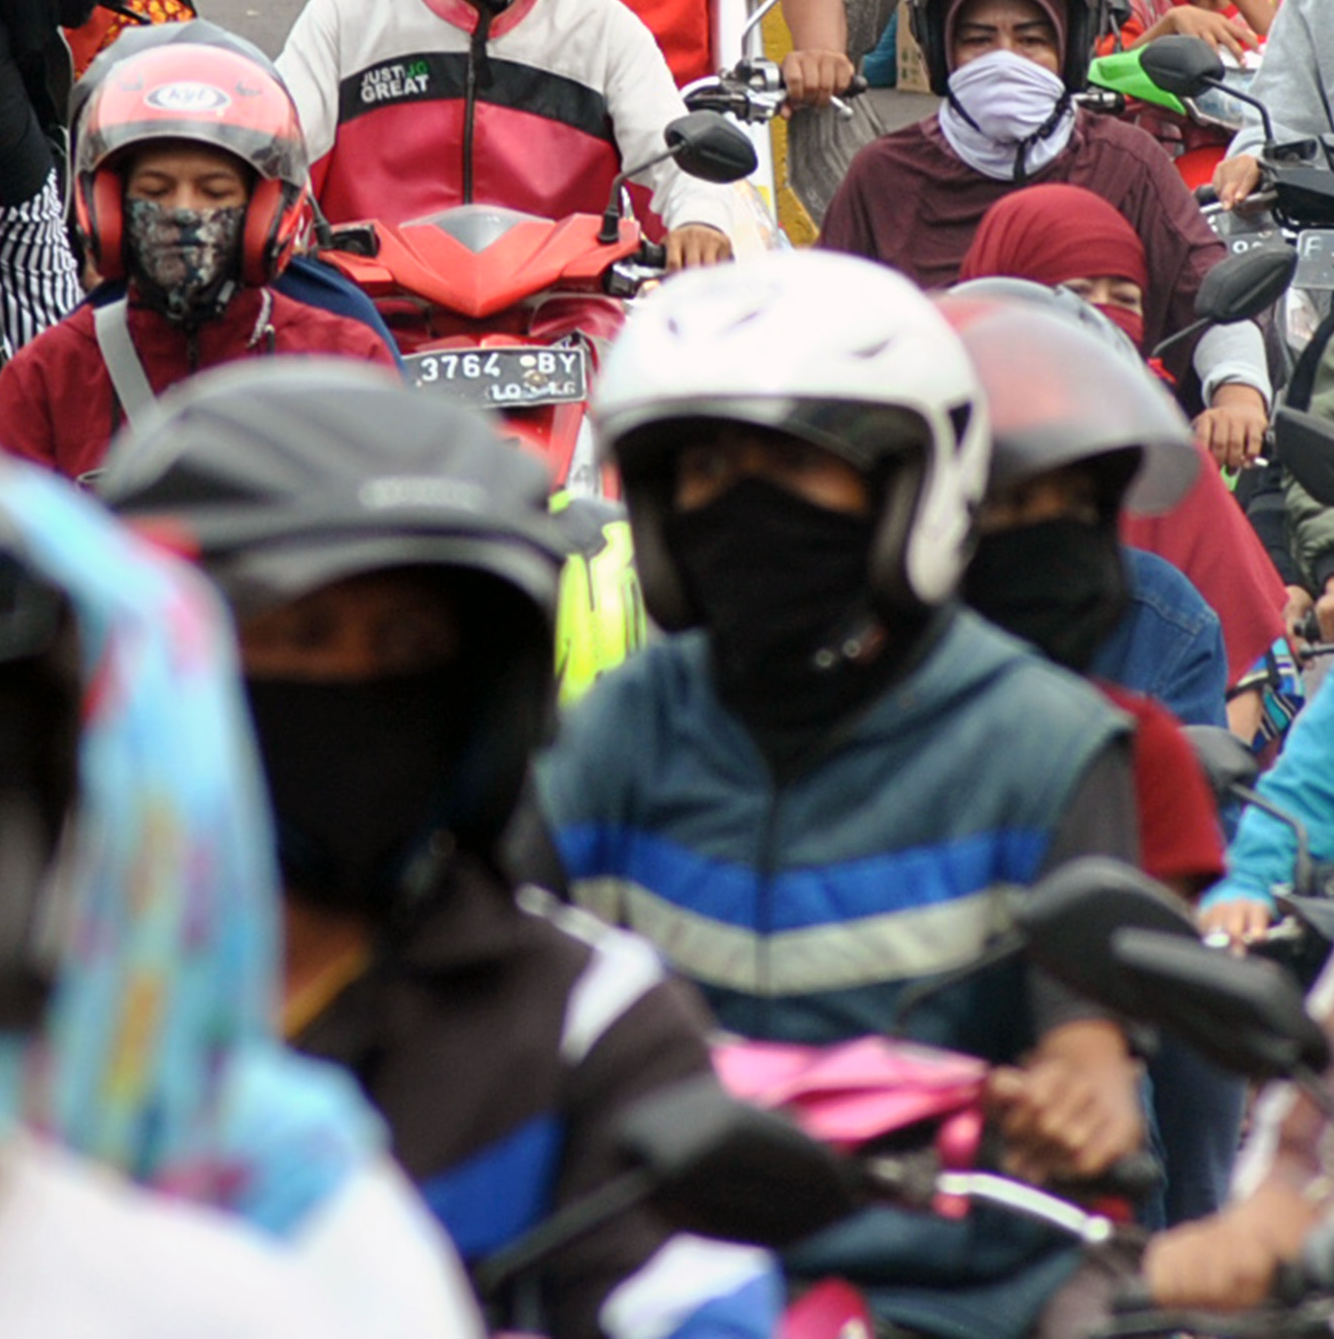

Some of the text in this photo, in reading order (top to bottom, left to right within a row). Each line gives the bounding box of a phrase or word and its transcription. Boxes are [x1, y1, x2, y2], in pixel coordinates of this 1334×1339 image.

[361, 73, 429, 104] GREAT
[1303, 236, 1323, 258] F
[420, 352, 576, 382] 3764 BY
